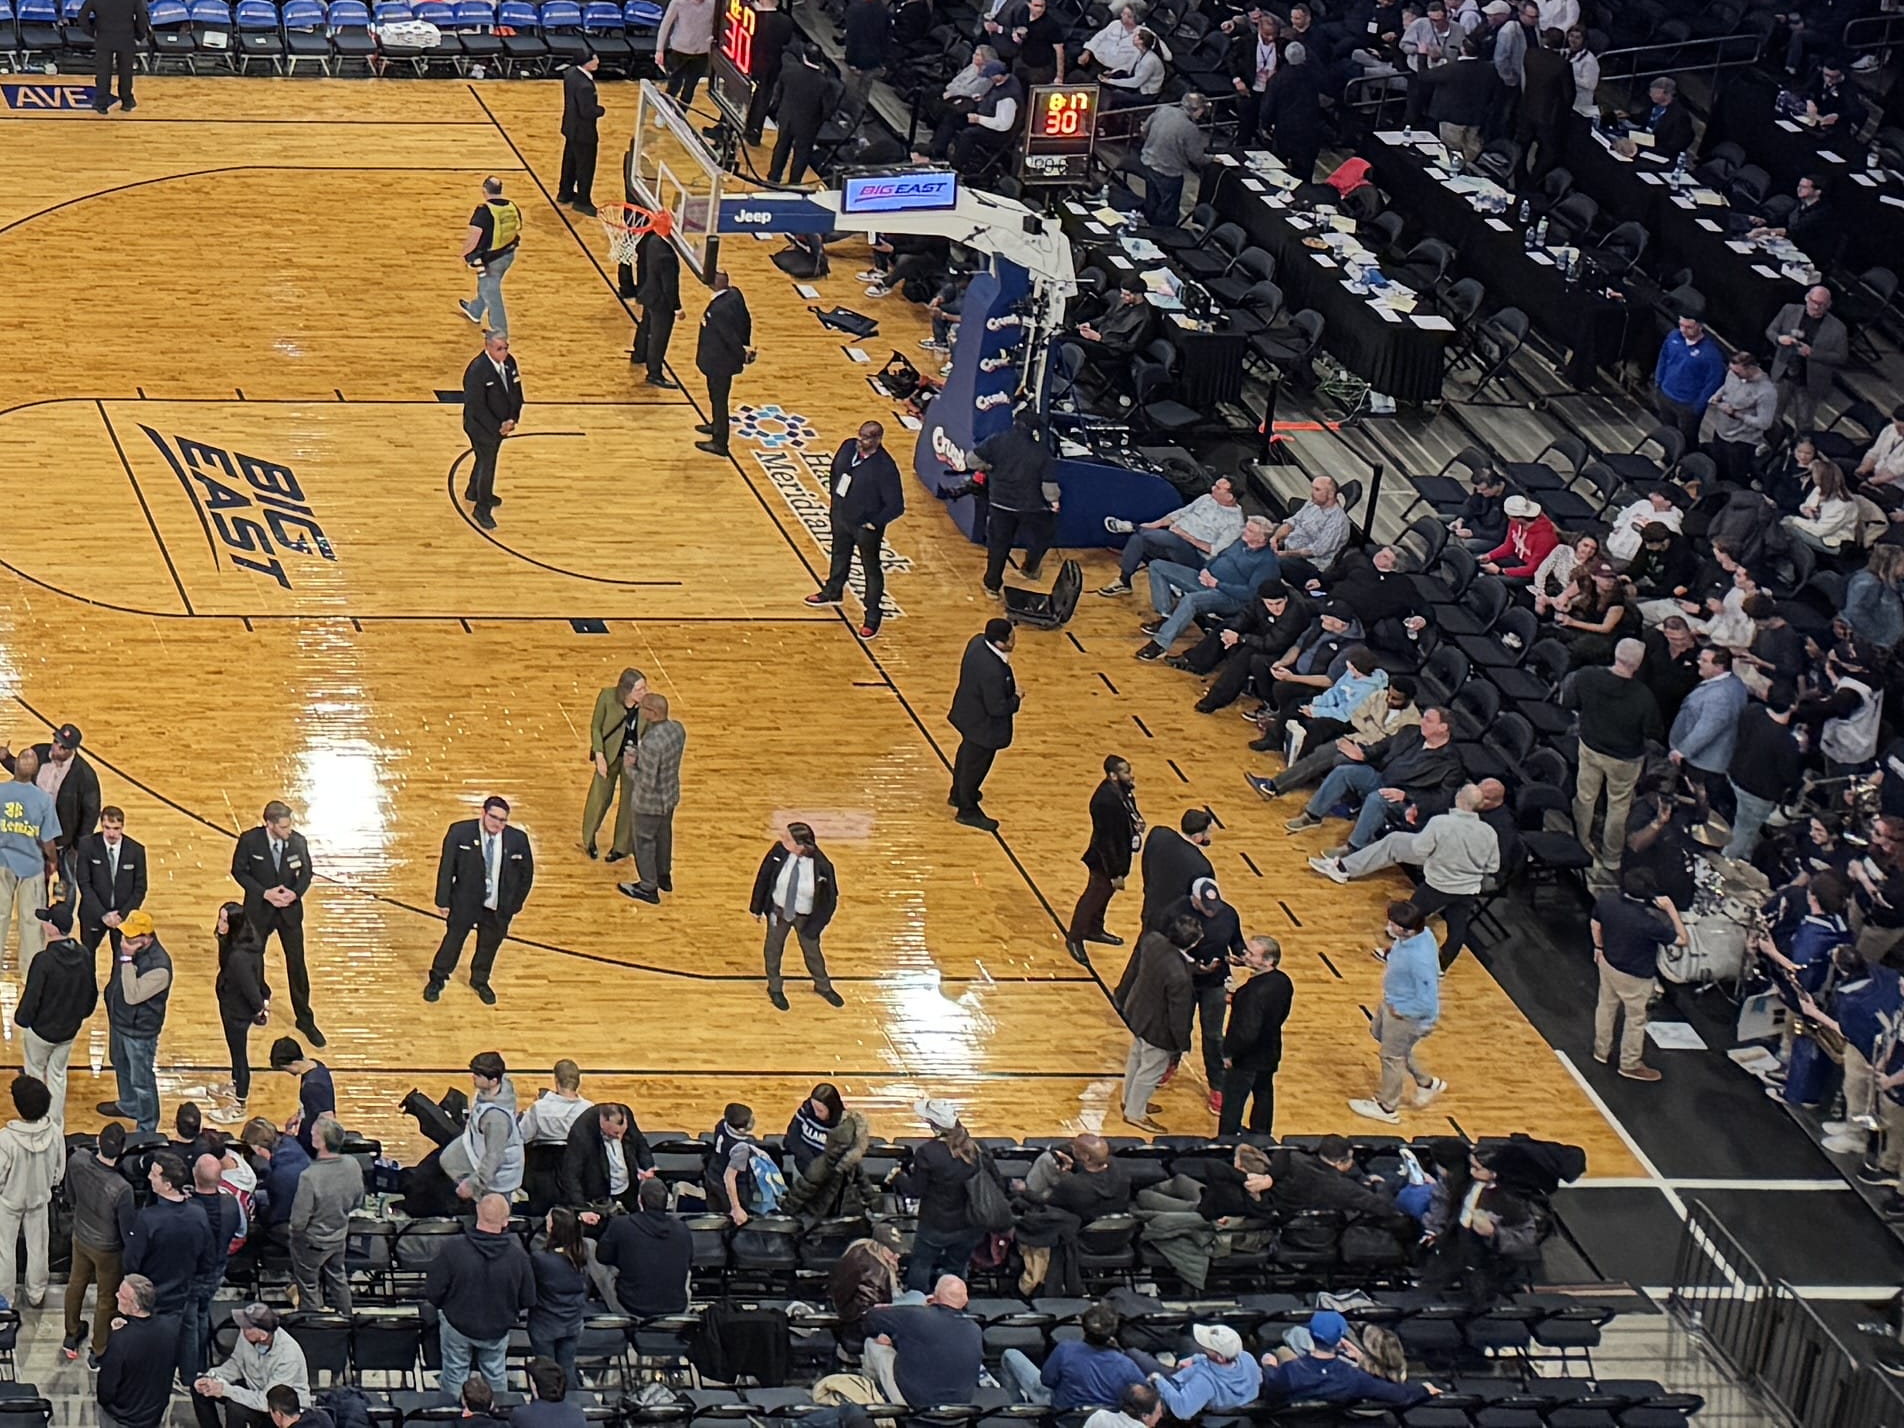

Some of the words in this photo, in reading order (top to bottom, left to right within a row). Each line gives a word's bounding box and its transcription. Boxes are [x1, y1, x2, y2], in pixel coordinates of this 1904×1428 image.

[1045, 110, 1078, 135] 30
[857, 183, 894, 197] BIG
[894, 181, 948, 196] EAST
[734, 209, 772, 225] Jeep
[173, 434, 293, 591] EAST
[232, 451, 339, 562] BIG
